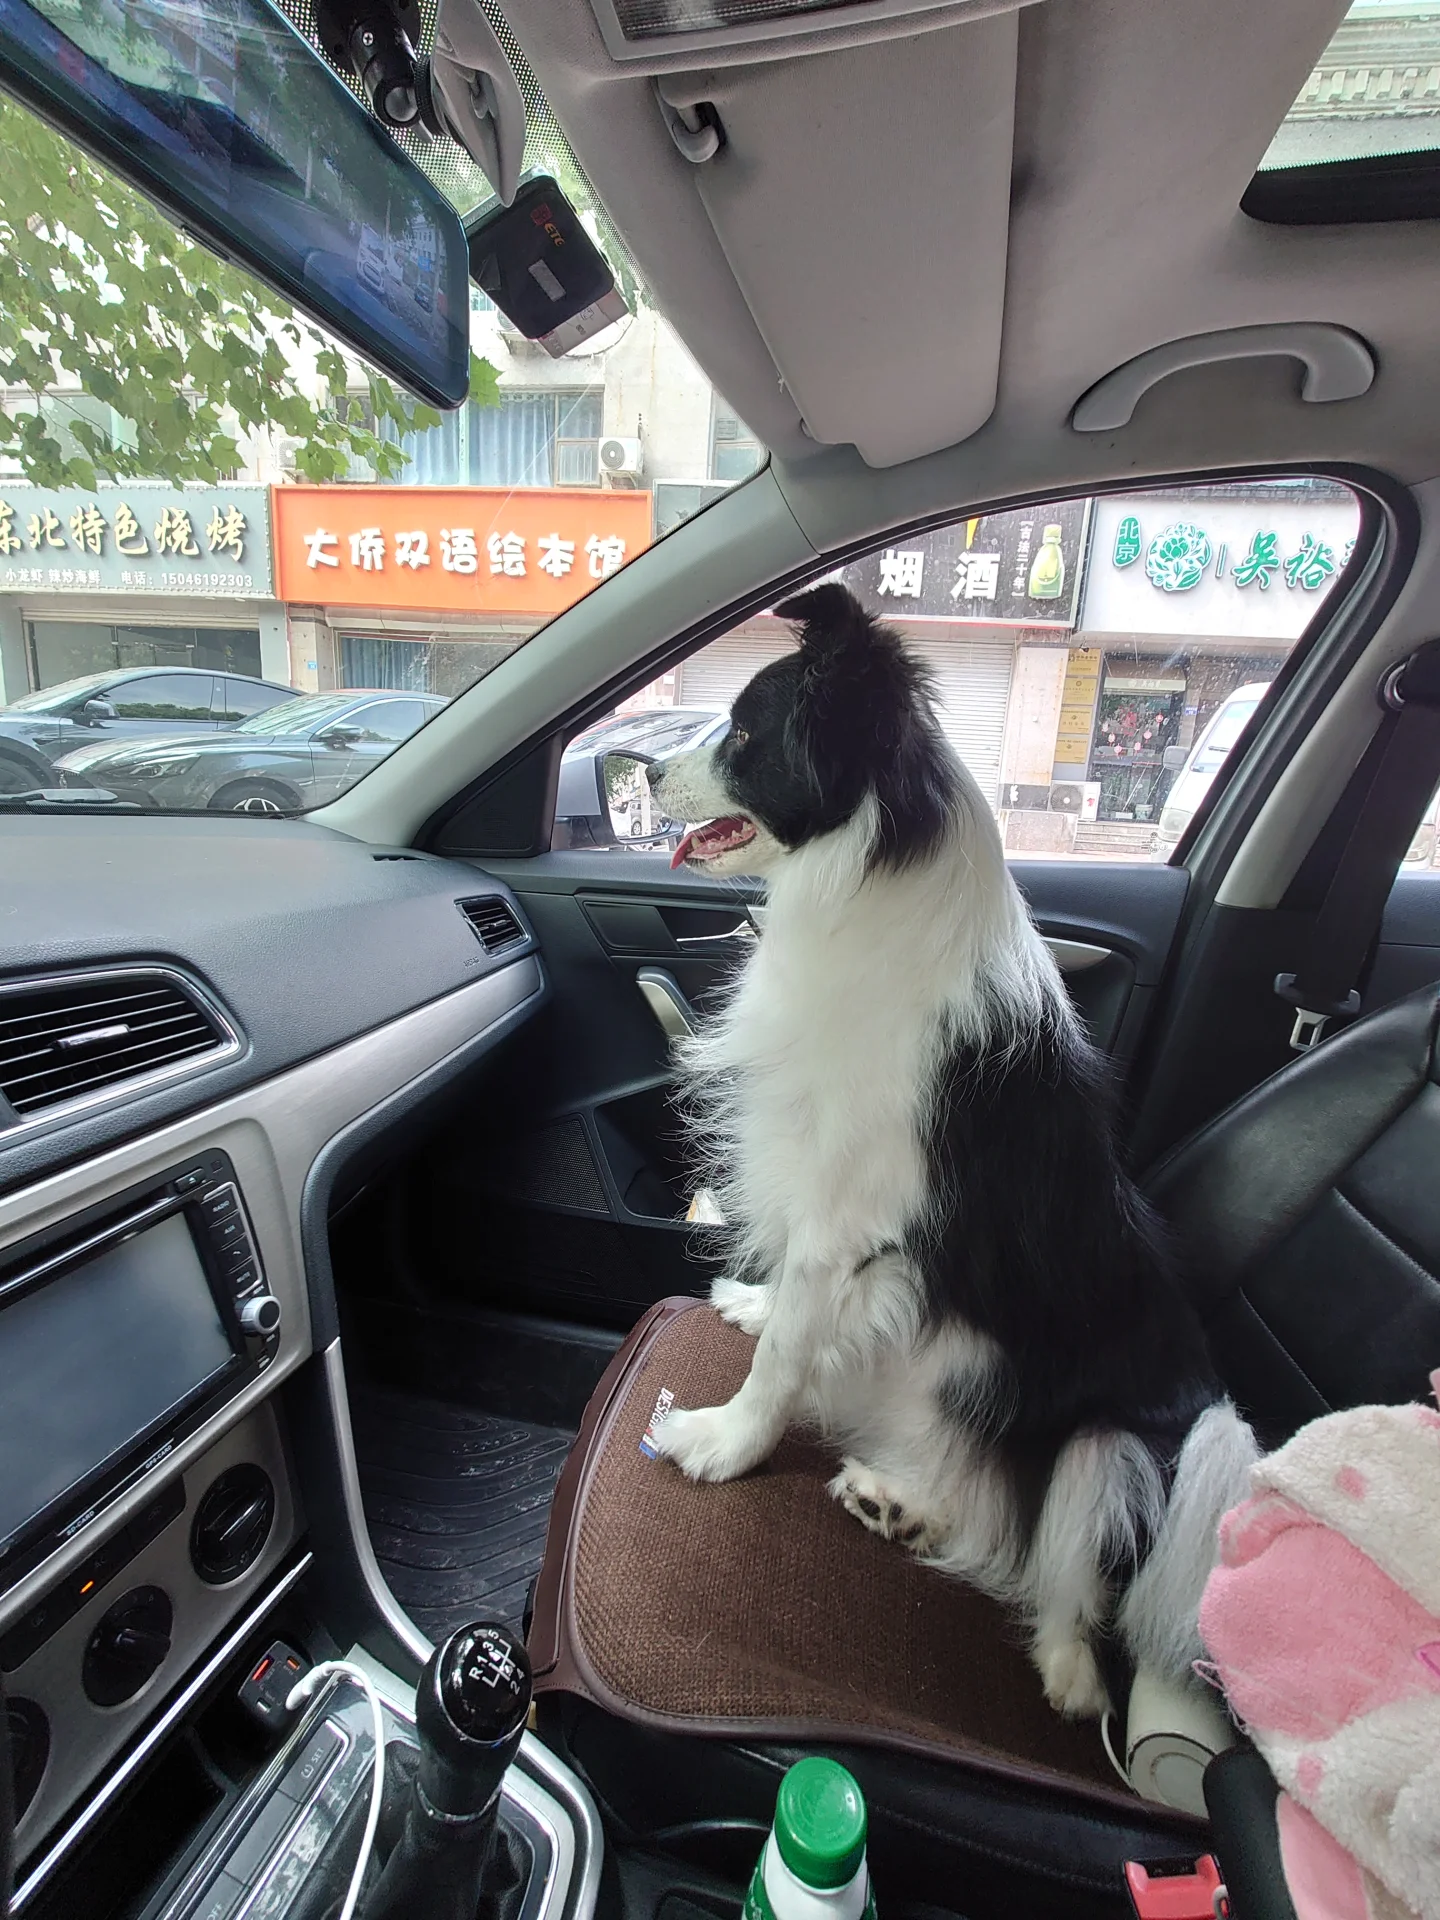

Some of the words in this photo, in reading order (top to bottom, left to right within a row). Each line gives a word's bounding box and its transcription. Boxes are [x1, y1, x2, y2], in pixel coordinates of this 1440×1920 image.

[544, 222, 565, 247] ETC
[1119, 521, 1139, 561] 北京
[1231, 530, 1357, 590] 吴裕
[877, 549, 1000, 600] 烟酒
[145, 1445, 172, 1469] GPS-CARD
[67, 1510, 94, 1535] SD-CARD
[482, 1641, 495, 1652] 3
[487, 1629, 500, 1640] 5
[469, 1667, 482, 1680] R
[510, 1680, 521, 1695] 2
[311, 1748, 324, 1763] SET
